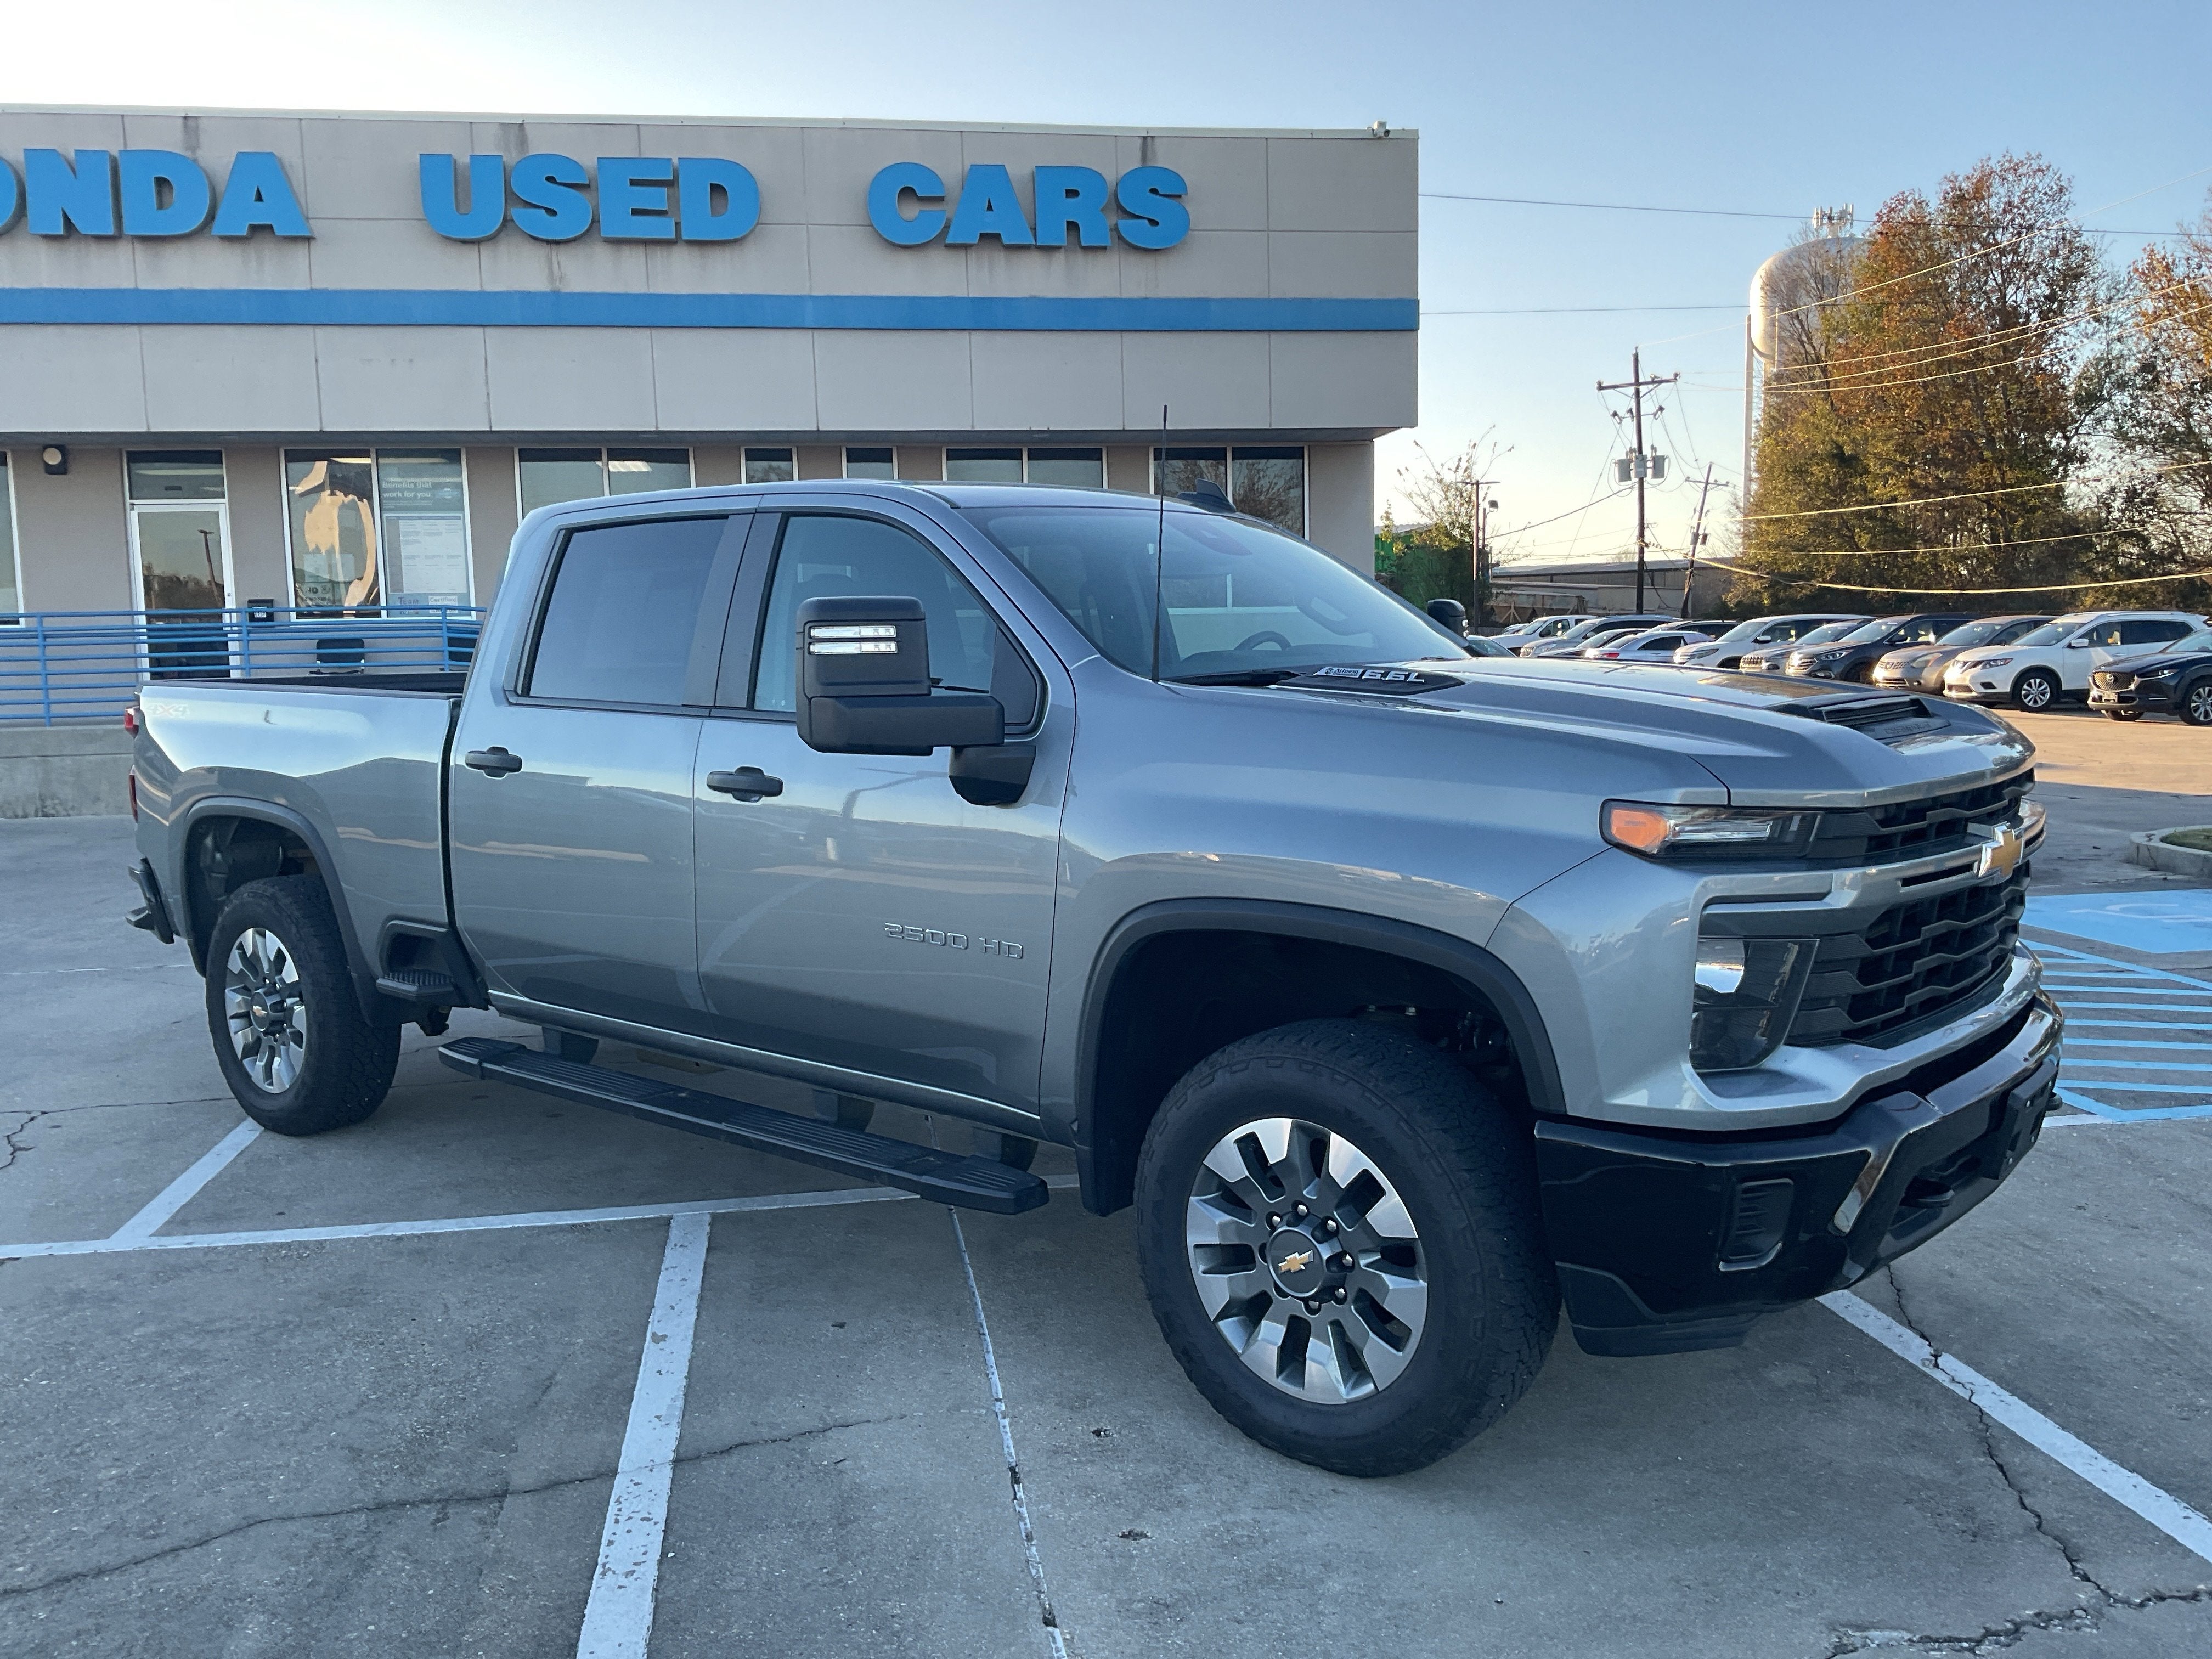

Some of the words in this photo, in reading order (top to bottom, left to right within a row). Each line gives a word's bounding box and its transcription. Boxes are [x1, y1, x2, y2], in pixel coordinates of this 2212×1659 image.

[0, 148, 314, 238] NDA
[419, 154, 761, 242] USED
[867, 162, 1190, 249] CARS
[1362, 670, 1425, 682] 6.6L
[884, 922, 968, 950] 2500
[979, 937, 1024, 959] HD
